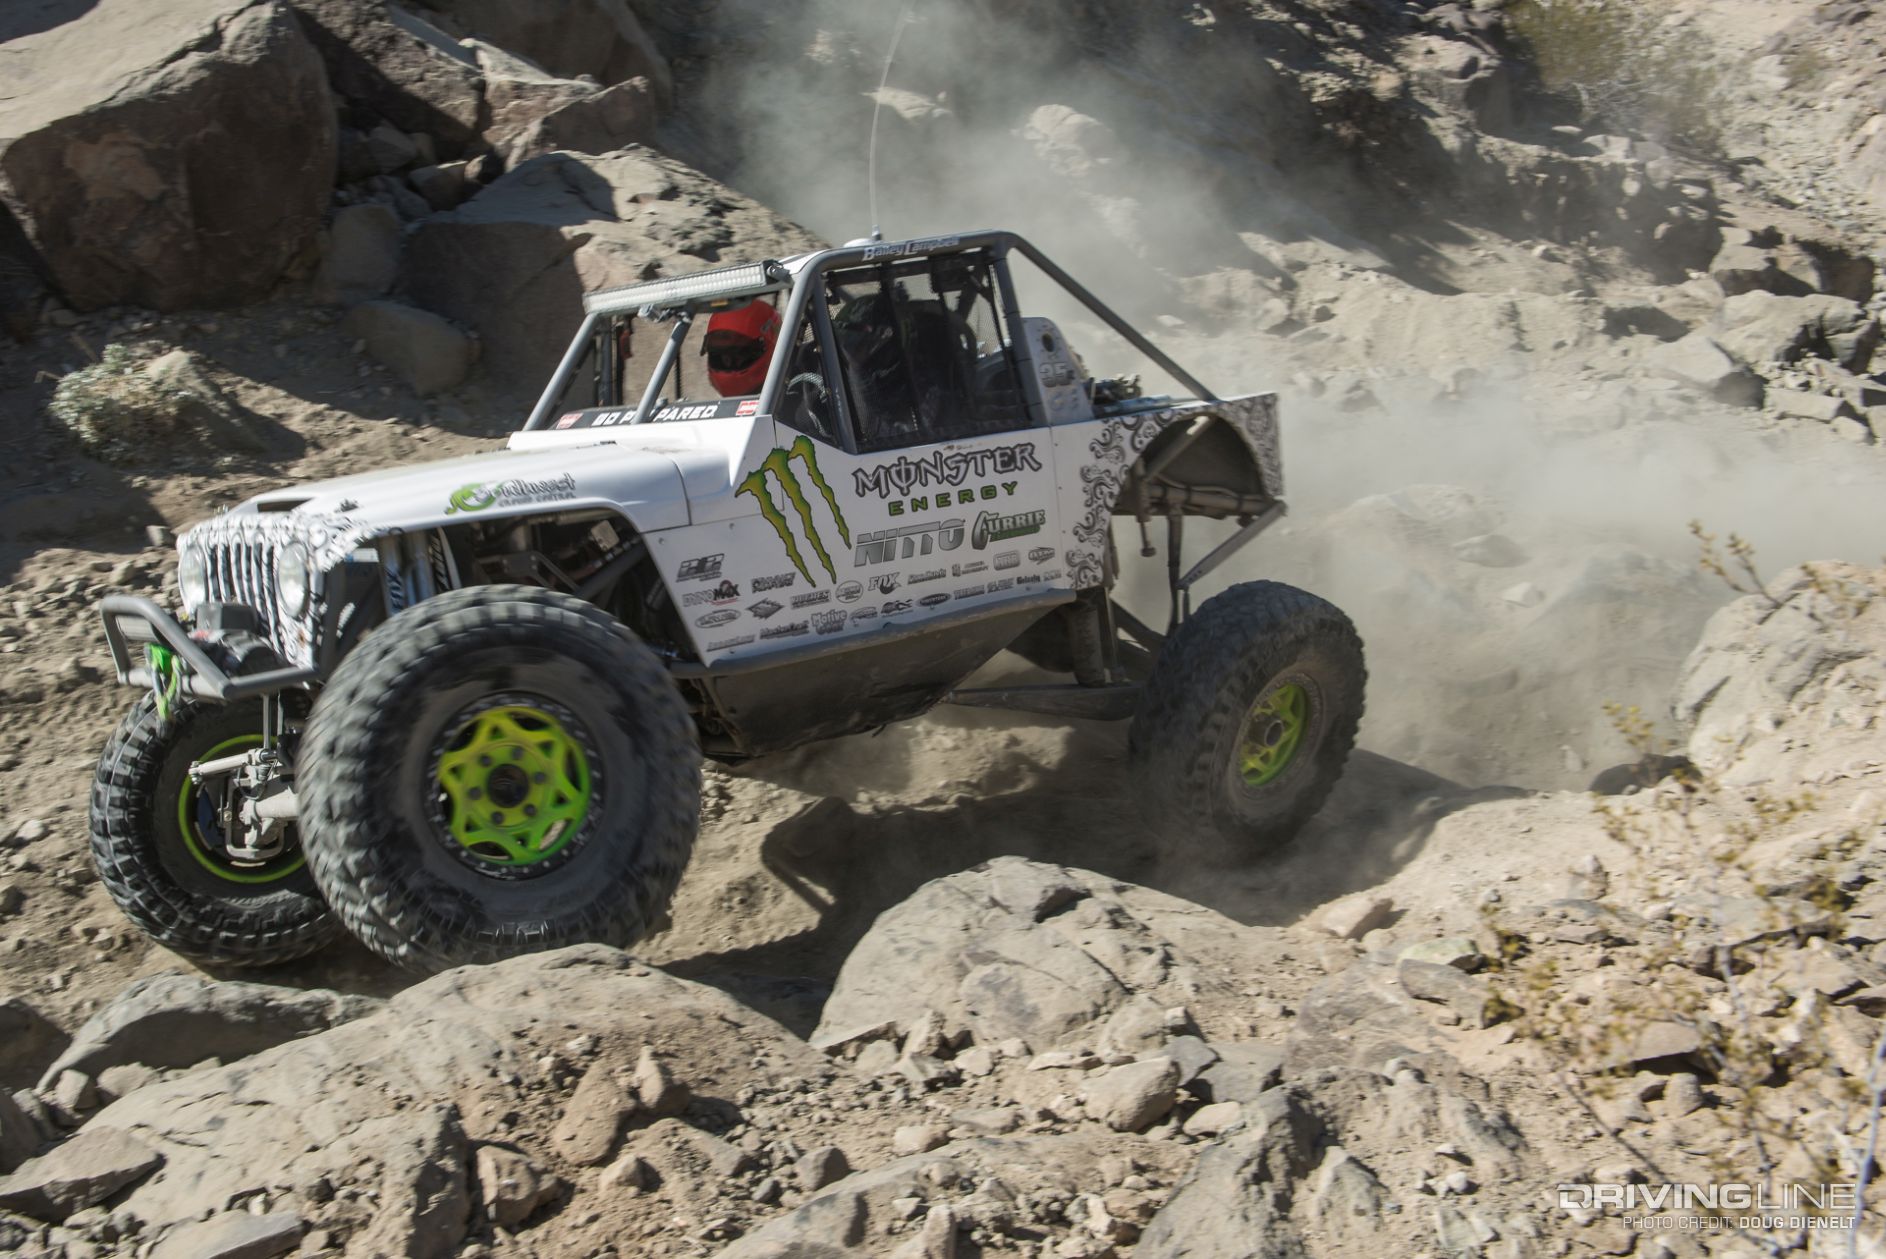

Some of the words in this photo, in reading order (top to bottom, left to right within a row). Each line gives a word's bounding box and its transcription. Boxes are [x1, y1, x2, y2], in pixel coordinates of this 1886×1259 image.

[851, 443, 1043, 499] MONSTER
[888, 481, 1018, 517] ENERGY
[853, 518, 967, 568] NITTO
[971, 508, 1046, 550] CURRIE
[867, 571, 902, 595] FOX
